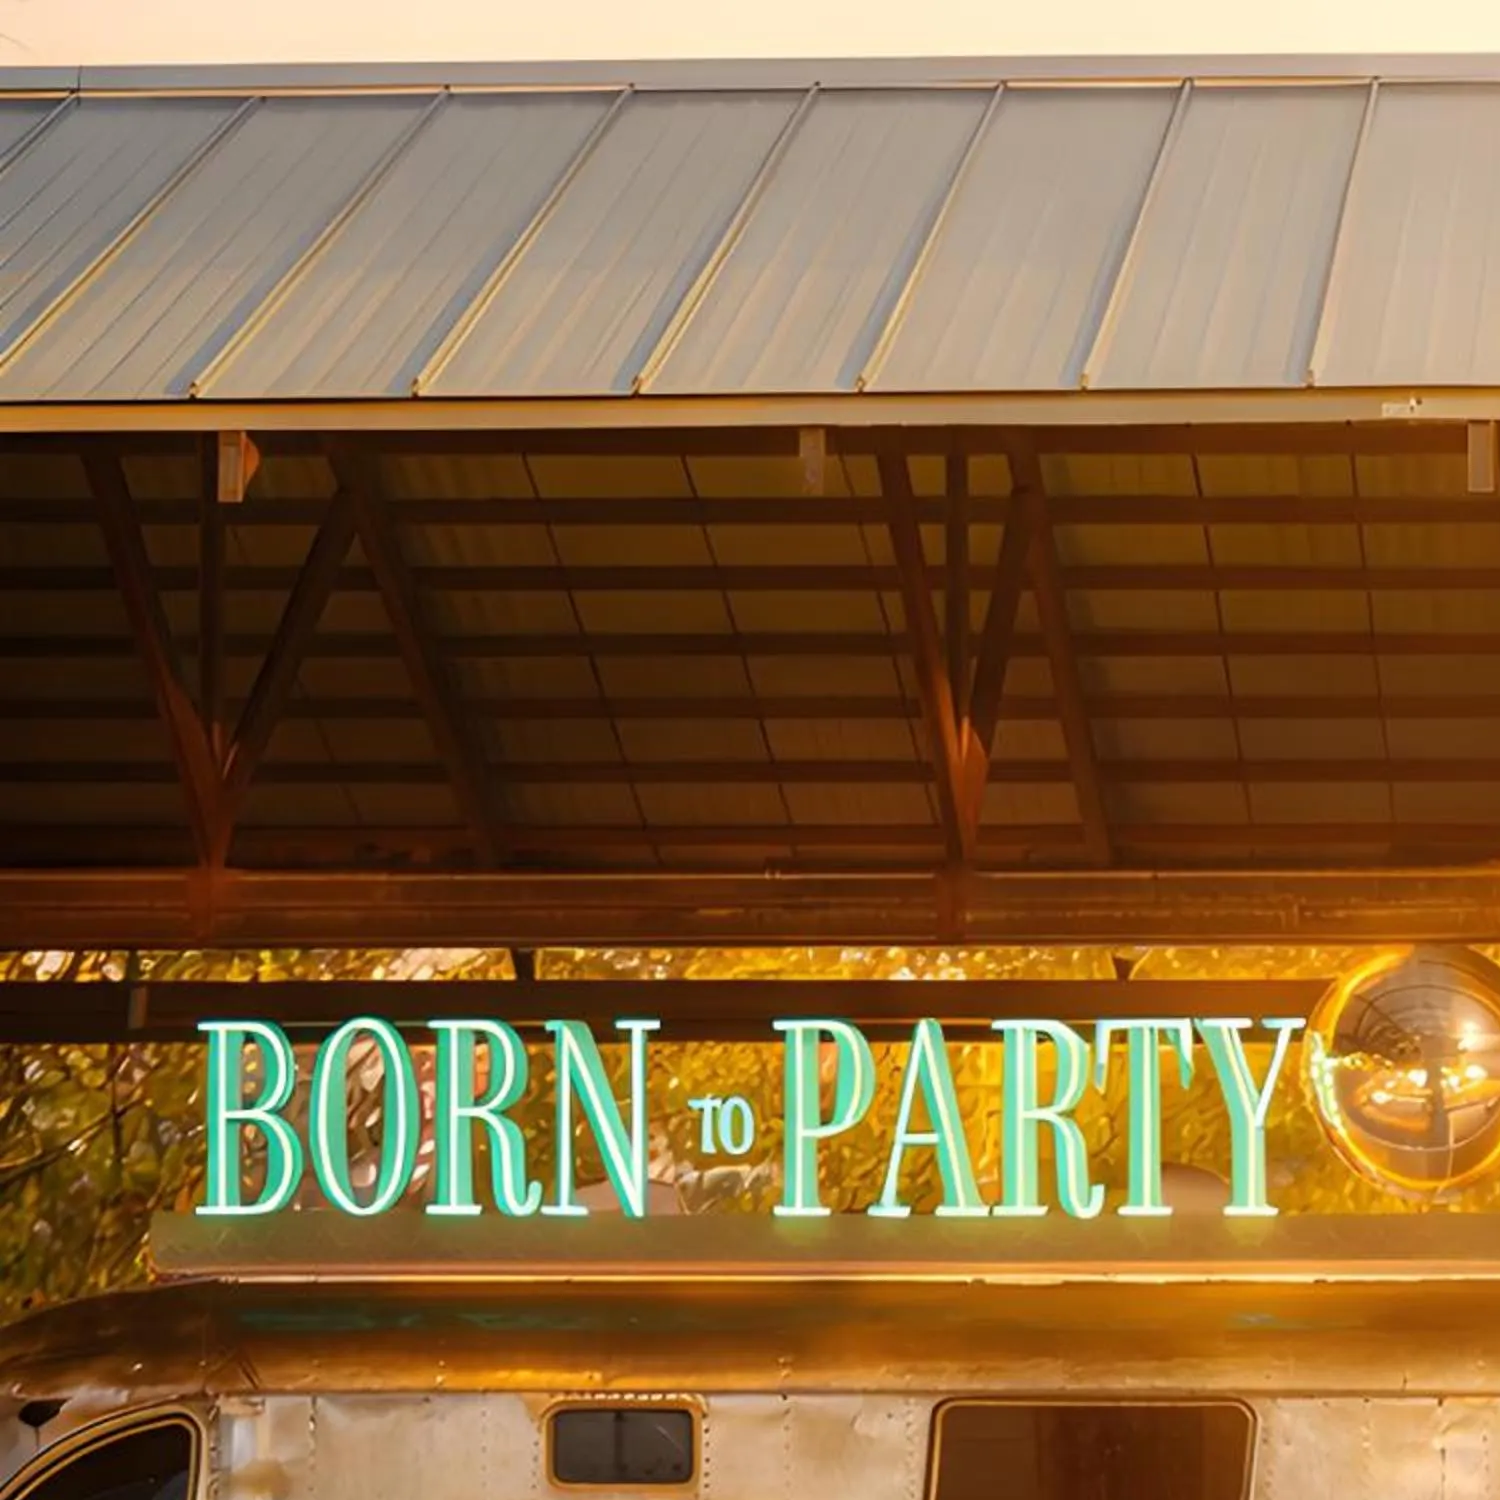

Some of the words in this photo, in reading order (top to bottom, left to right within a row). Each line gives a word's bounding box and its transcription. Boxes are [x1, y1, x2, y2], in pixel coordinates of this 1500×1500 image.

[196, 1016, 661, 1217] BORN
[688, 1095, 755, 1155] TO
[773, 1018, 1306, 1219] PARTY
